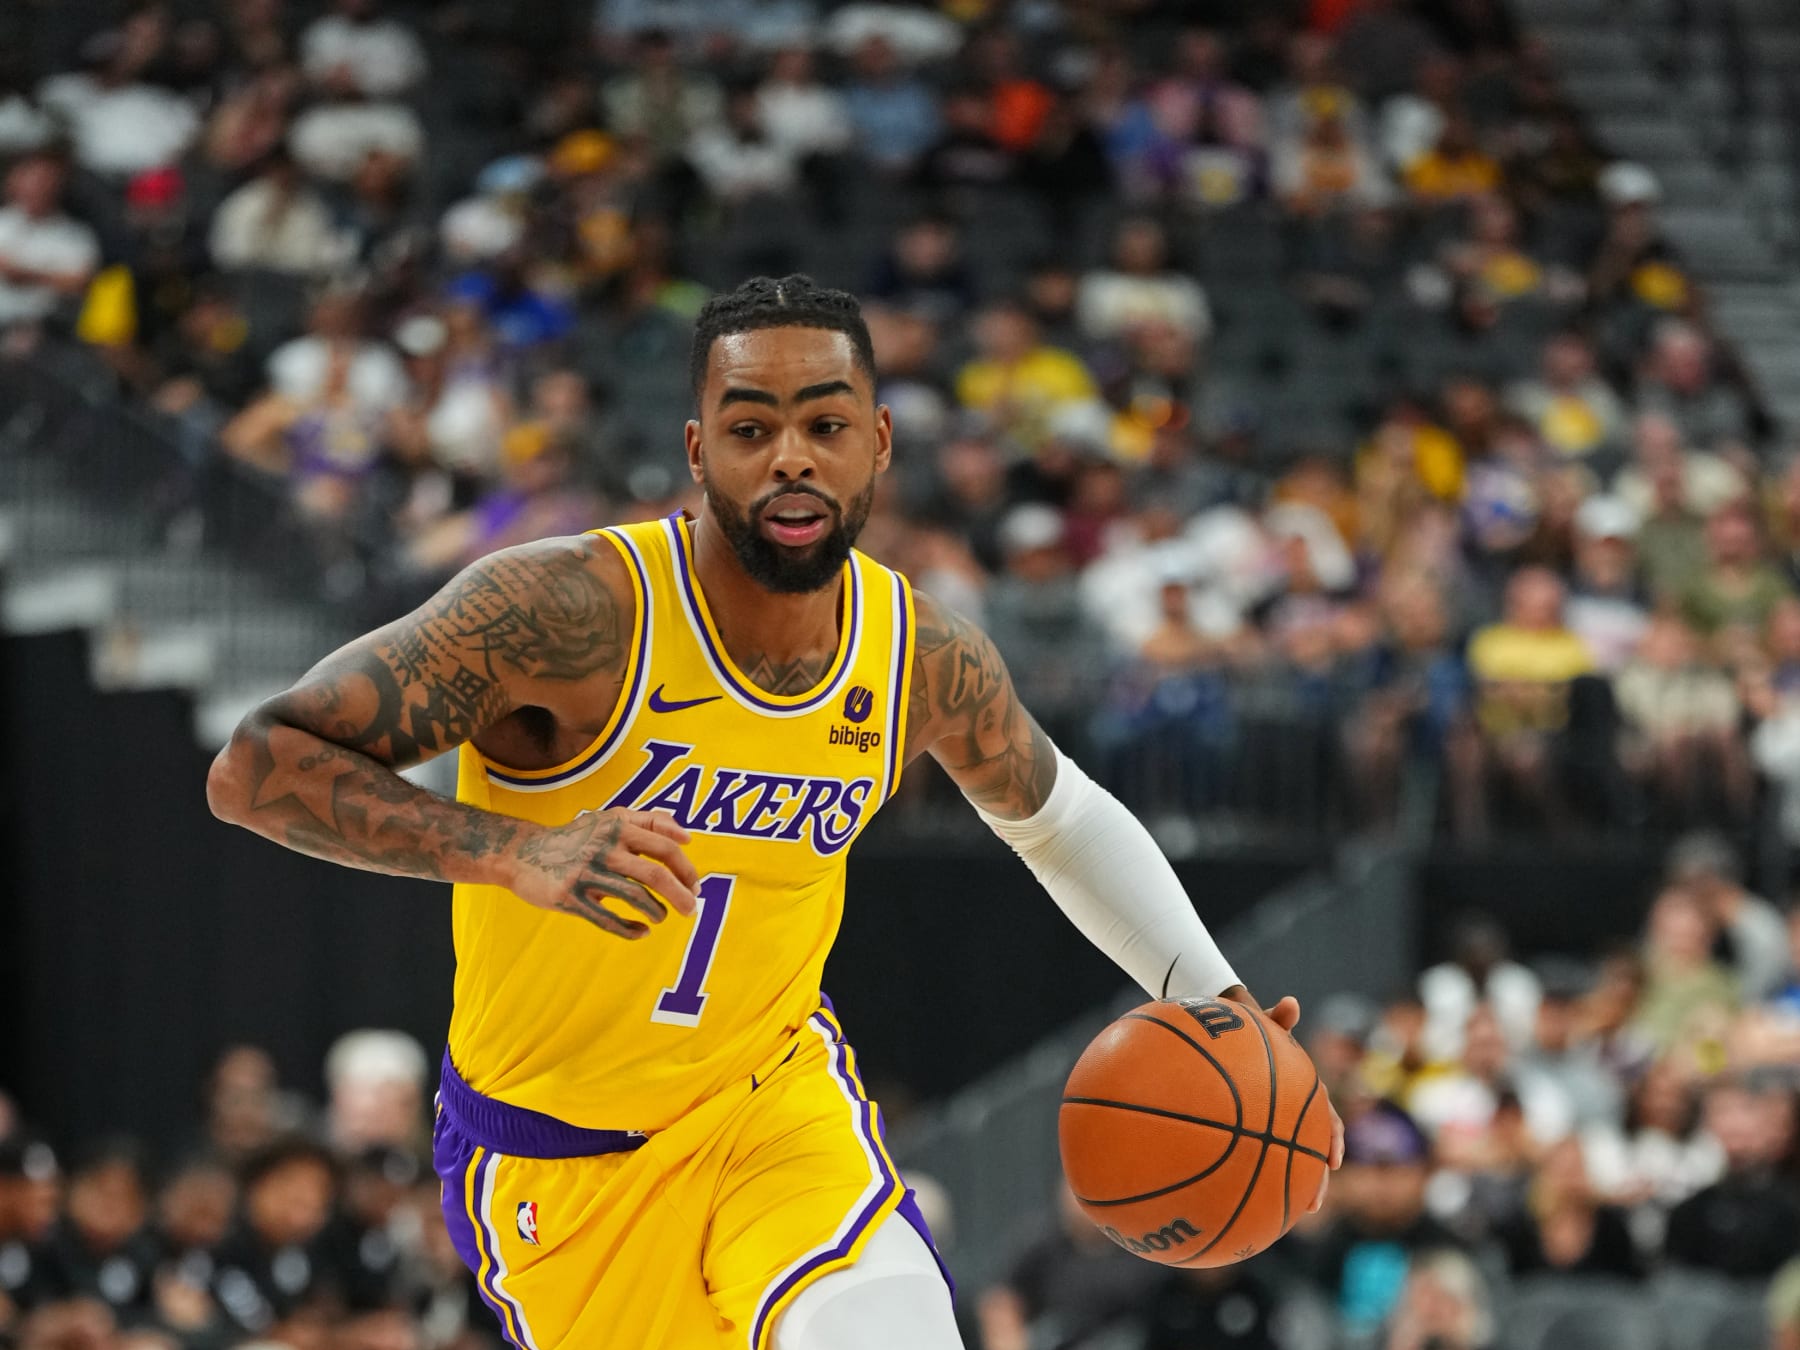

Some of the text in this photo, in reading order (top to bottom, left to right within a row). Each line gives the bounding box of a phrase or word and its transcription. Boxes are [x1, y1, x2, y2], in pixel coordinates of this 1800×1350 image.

[576, 738, 876, 858] LAKERS
[828, 724, 881, 753] bibigo
[650, 872, 737, 1028] 1
